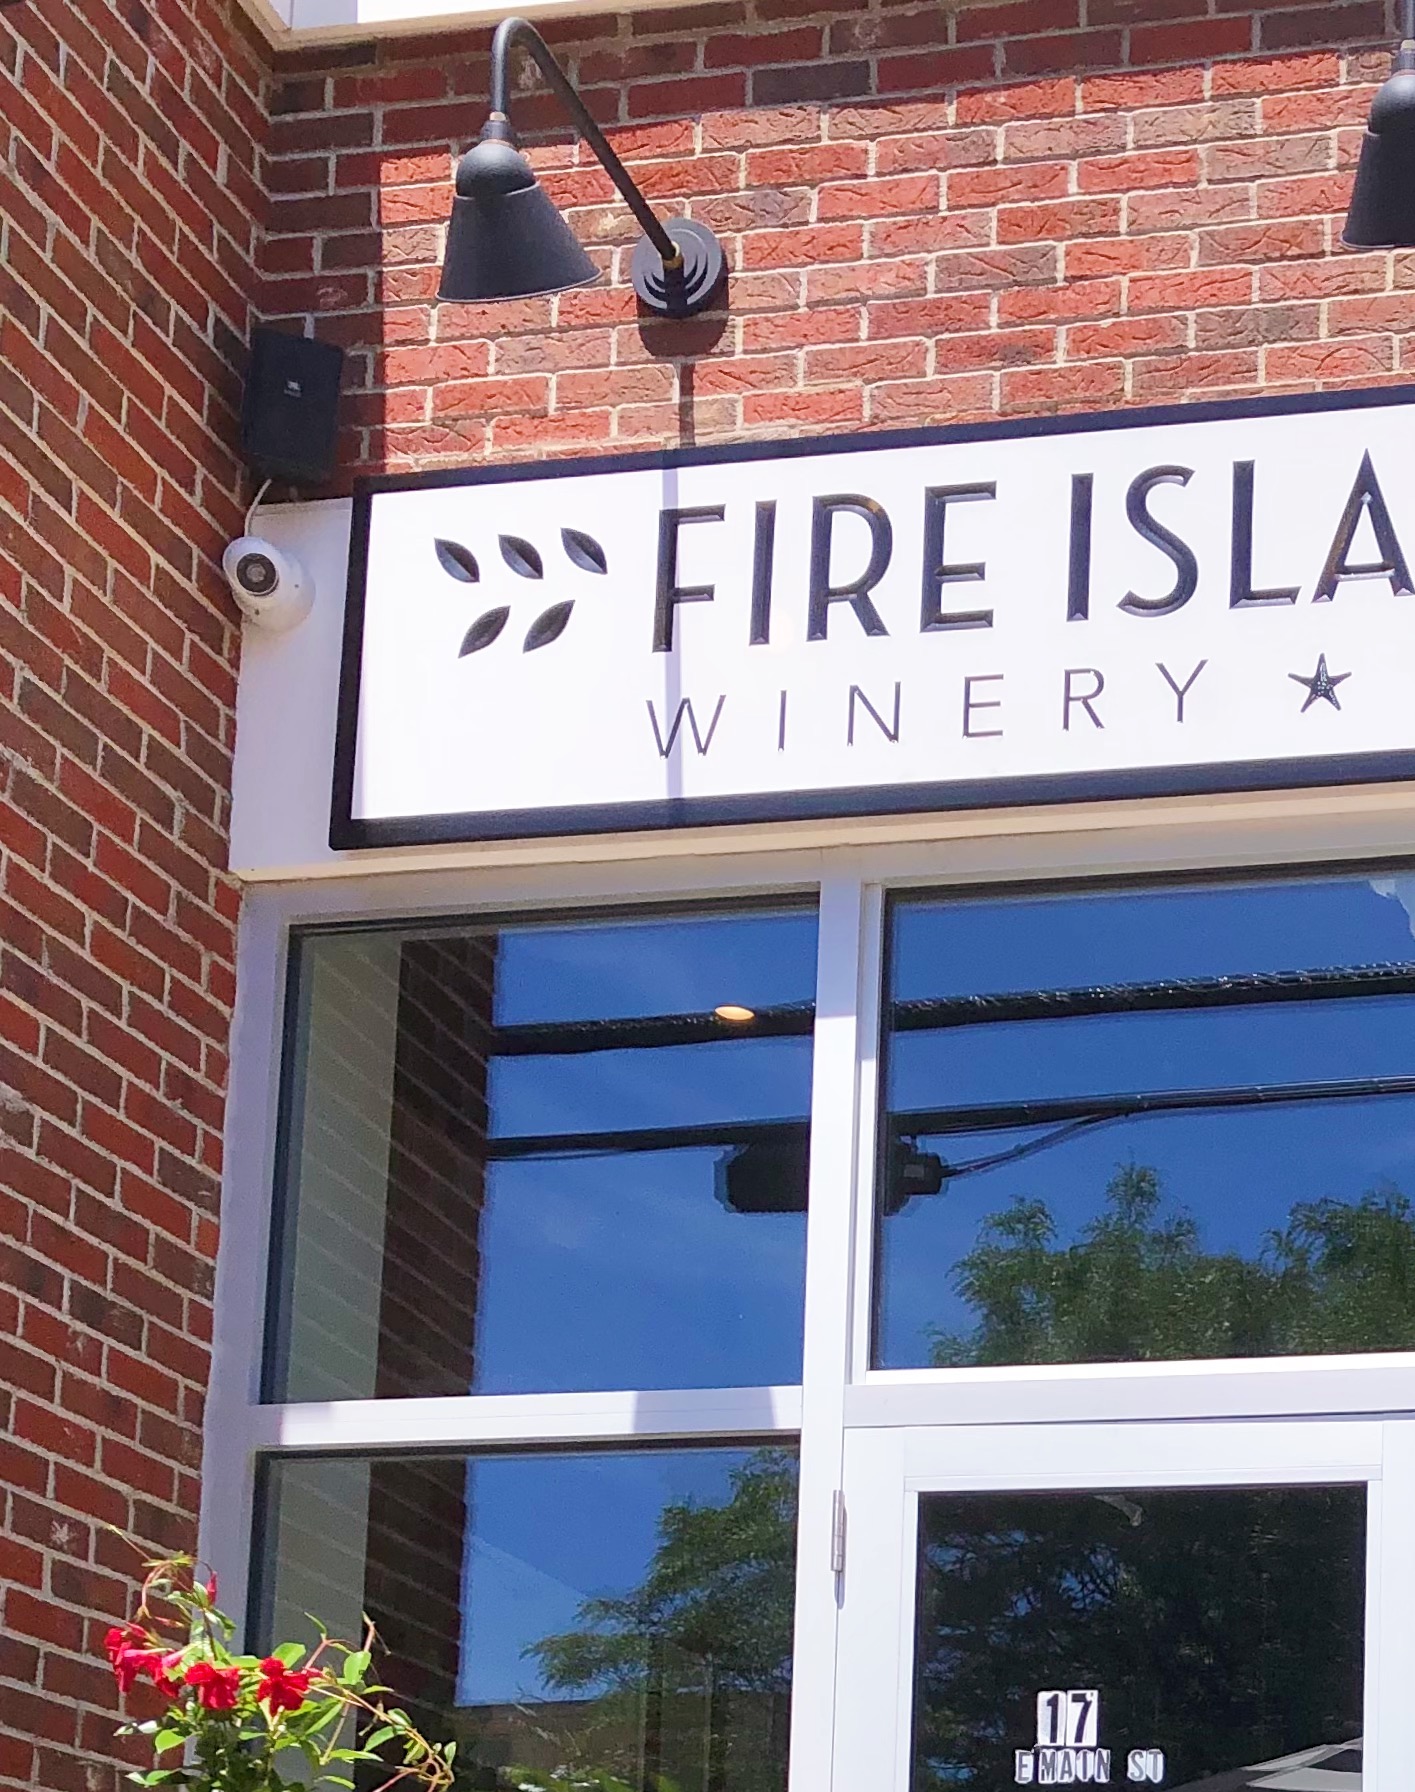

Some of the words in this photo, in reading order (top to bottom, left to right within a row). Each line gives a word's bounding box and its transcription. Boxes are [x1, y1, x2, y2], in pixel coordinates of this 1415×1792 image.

[652, 481, 997, 653] FIRE
[647, 659, 1208, 759] WINERY
[1042, 1691, 1096, 1745] 17
[1128, 1750, 1162, 1782] ST
